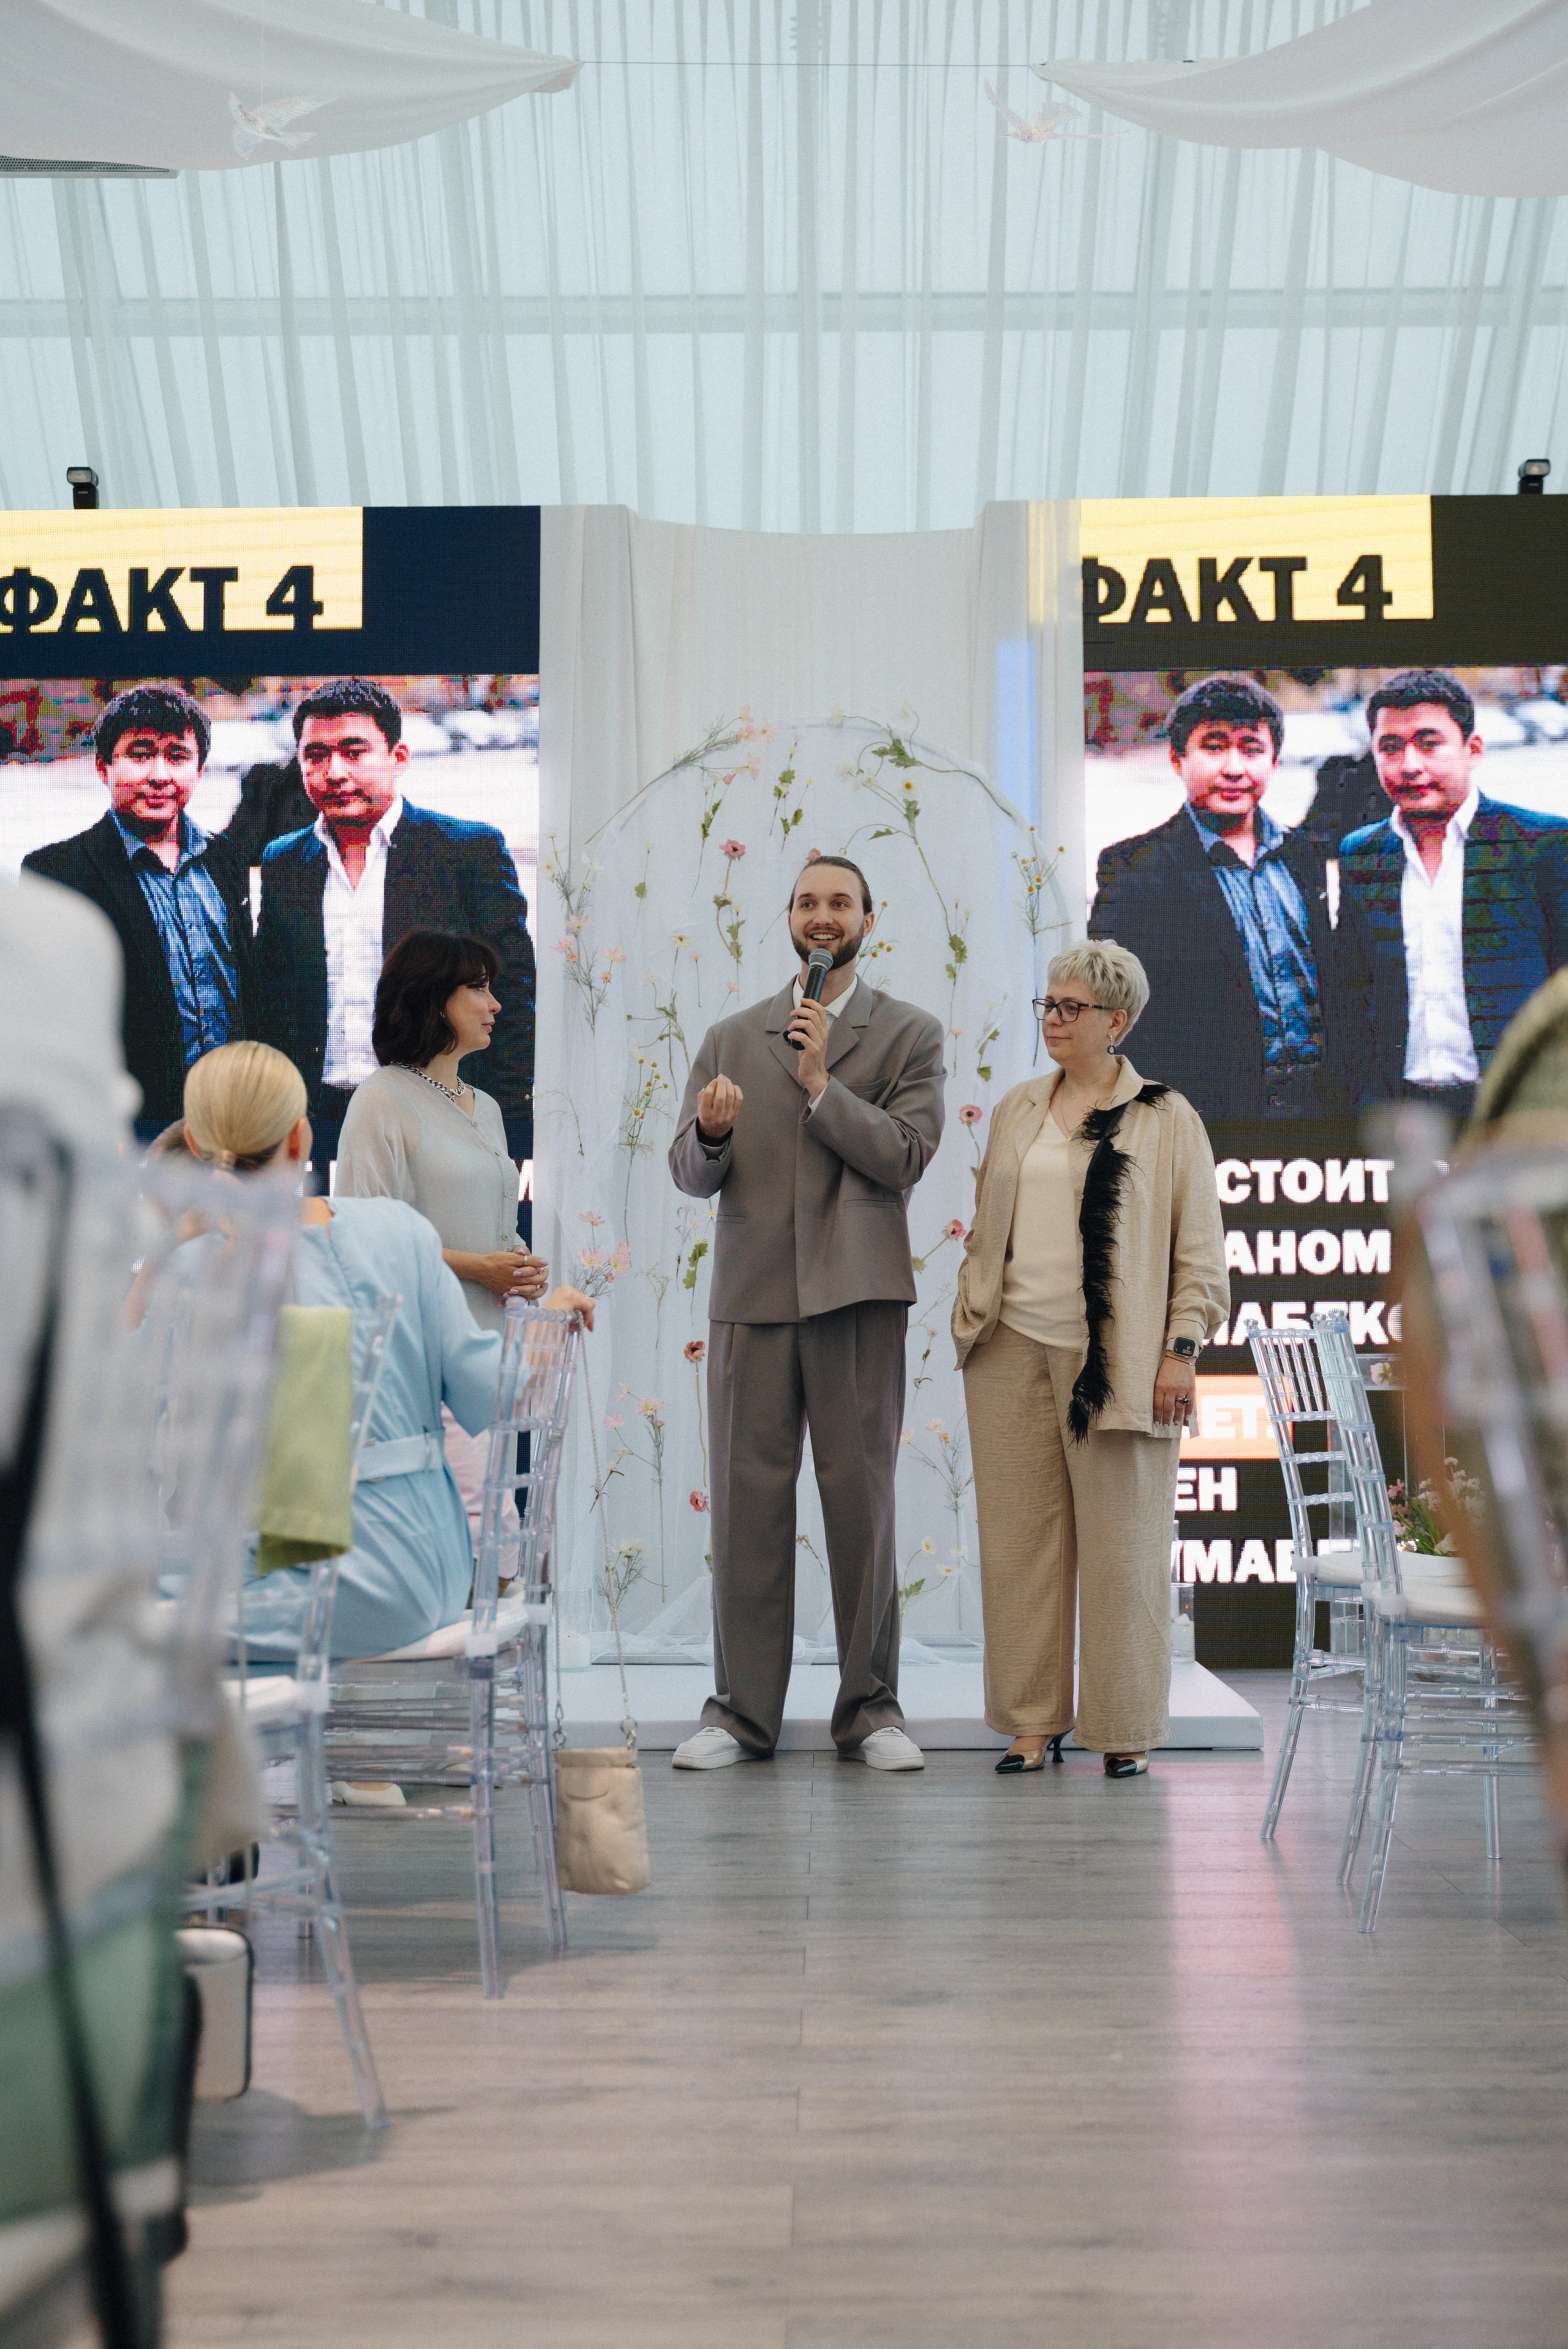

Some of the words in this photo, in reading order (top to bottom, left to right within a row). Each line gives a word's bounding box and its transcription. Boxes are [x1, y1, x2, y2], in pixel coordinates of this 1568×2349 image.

[0, 566, 238, 632] ФАКТ
[265, 565, 324, 630] 4
[1082, 556, 1308, 622] ФАКТ
[1336, 554, 1393, 620] 4
[1215, 1158, 1395, 1204] СТОИТ
